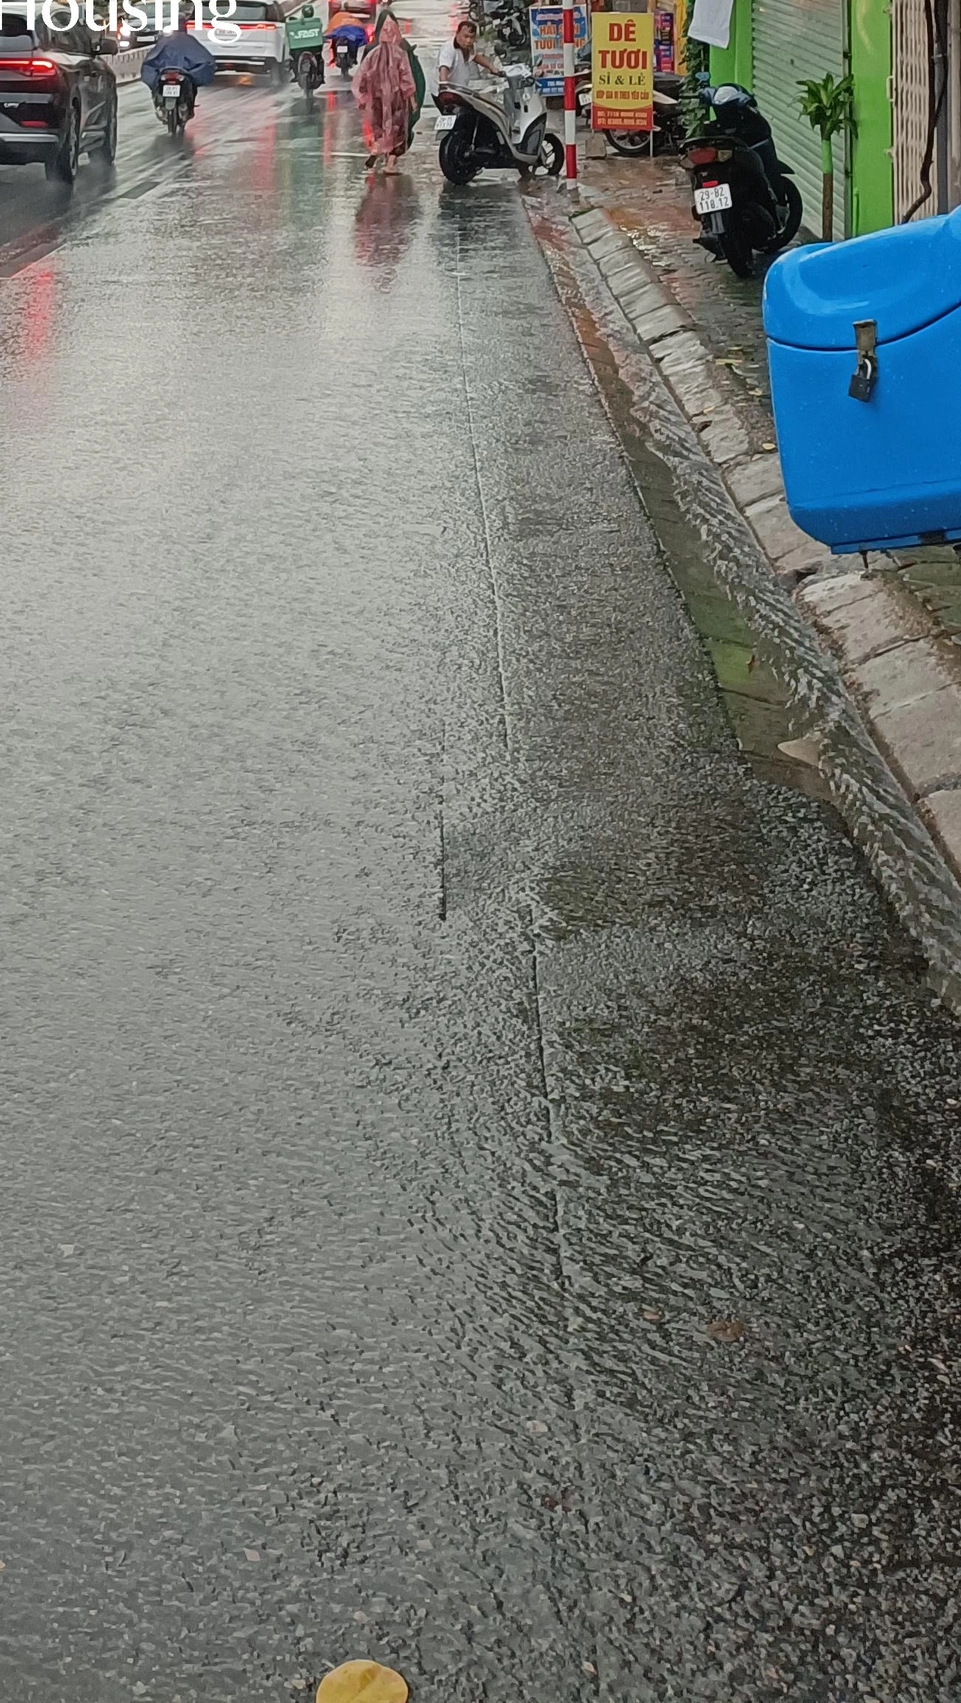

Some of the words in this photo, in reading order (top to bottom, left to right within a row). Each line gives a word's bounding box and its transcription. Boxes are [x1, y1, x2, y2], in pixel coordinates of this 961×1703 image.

[608, 19, 637, 42] DÊ
[598, 49, 648, 70] TƯƠI
[614, 75, 625, 86] &
[699, 196, 730, 212] 118.12
